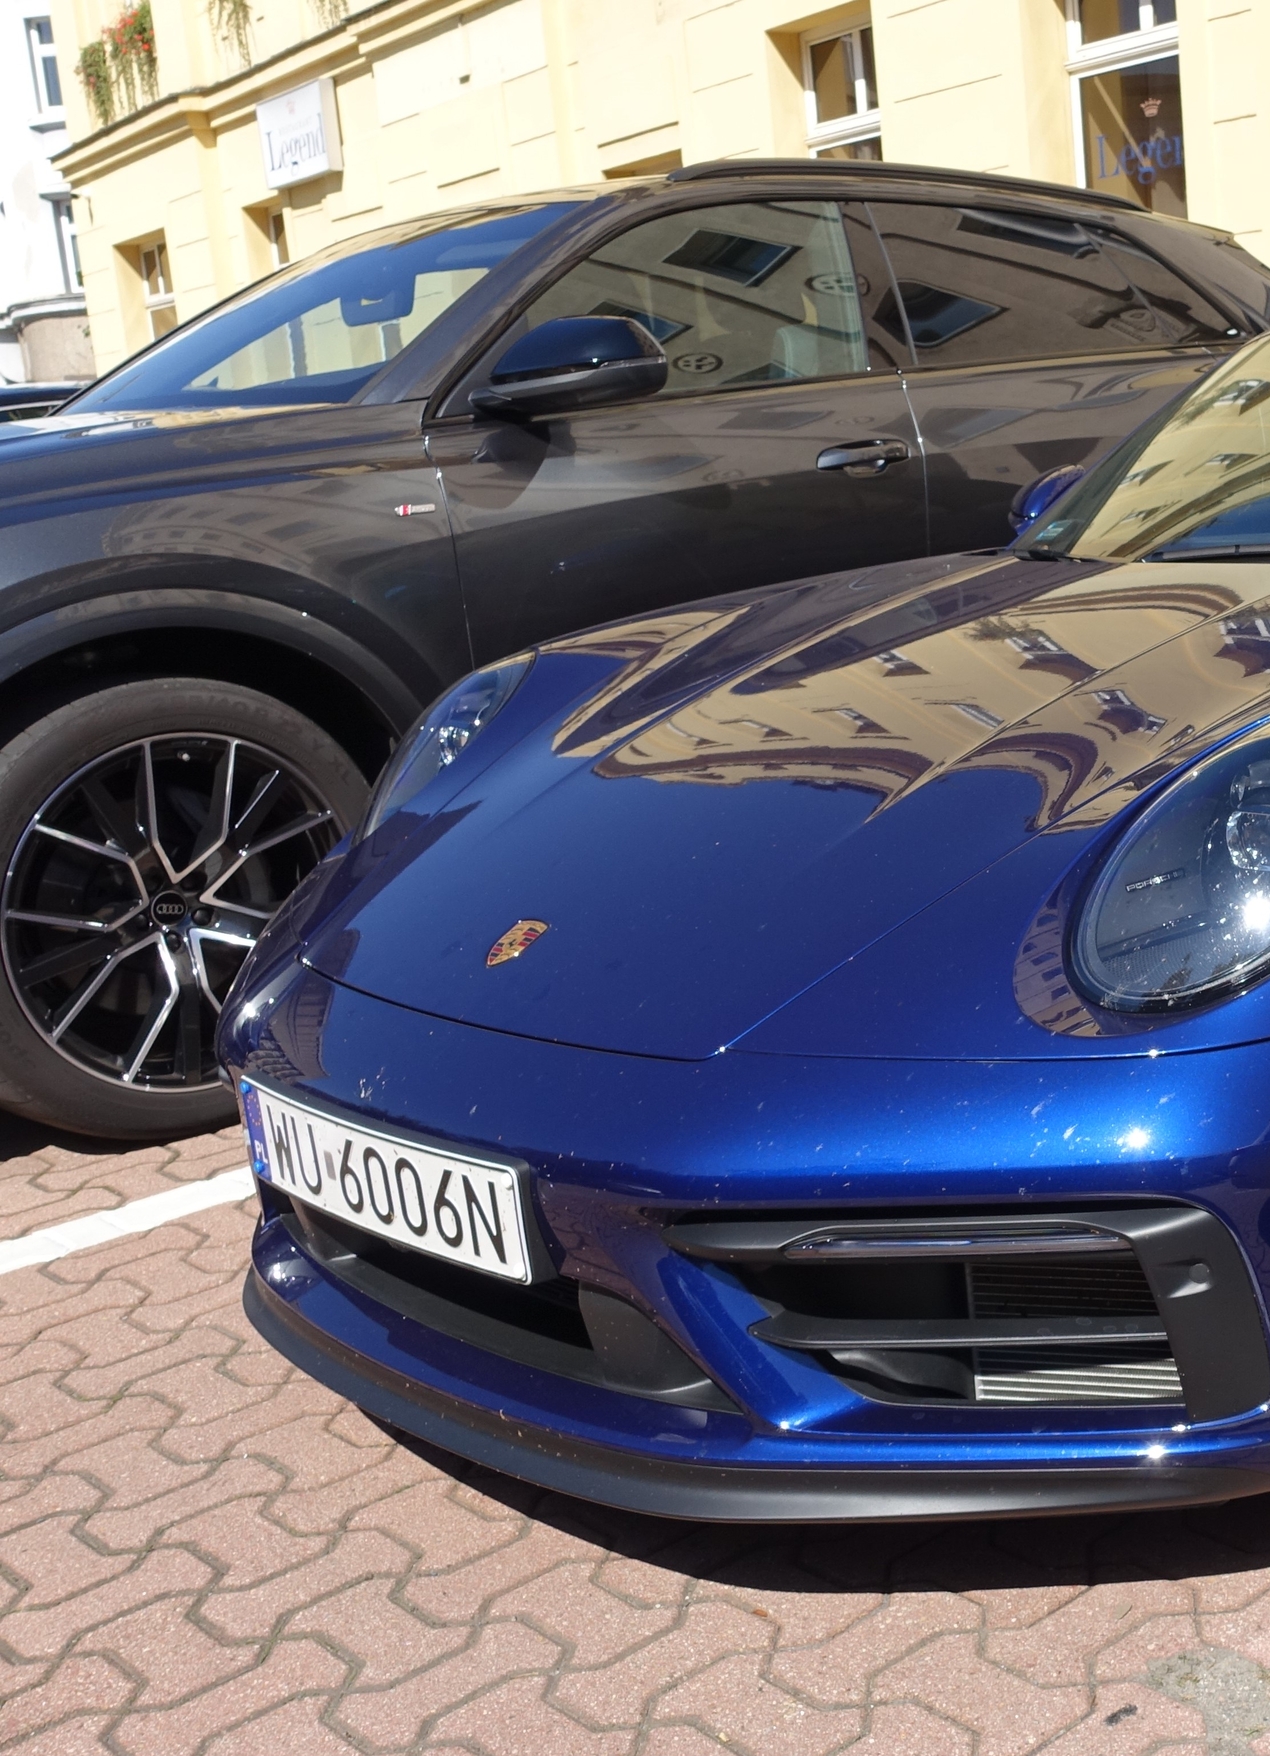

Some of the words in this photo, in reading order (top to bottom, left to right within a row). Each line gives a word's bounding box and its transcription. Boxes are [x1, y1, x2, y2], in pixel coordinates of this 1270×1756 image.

[265, 112, 326, 177] Legend
[254, 1139, 269, 1164] PL
[266, 1104, 322, 1196] WU
[340, 1139, 508, 1265] 6006N
